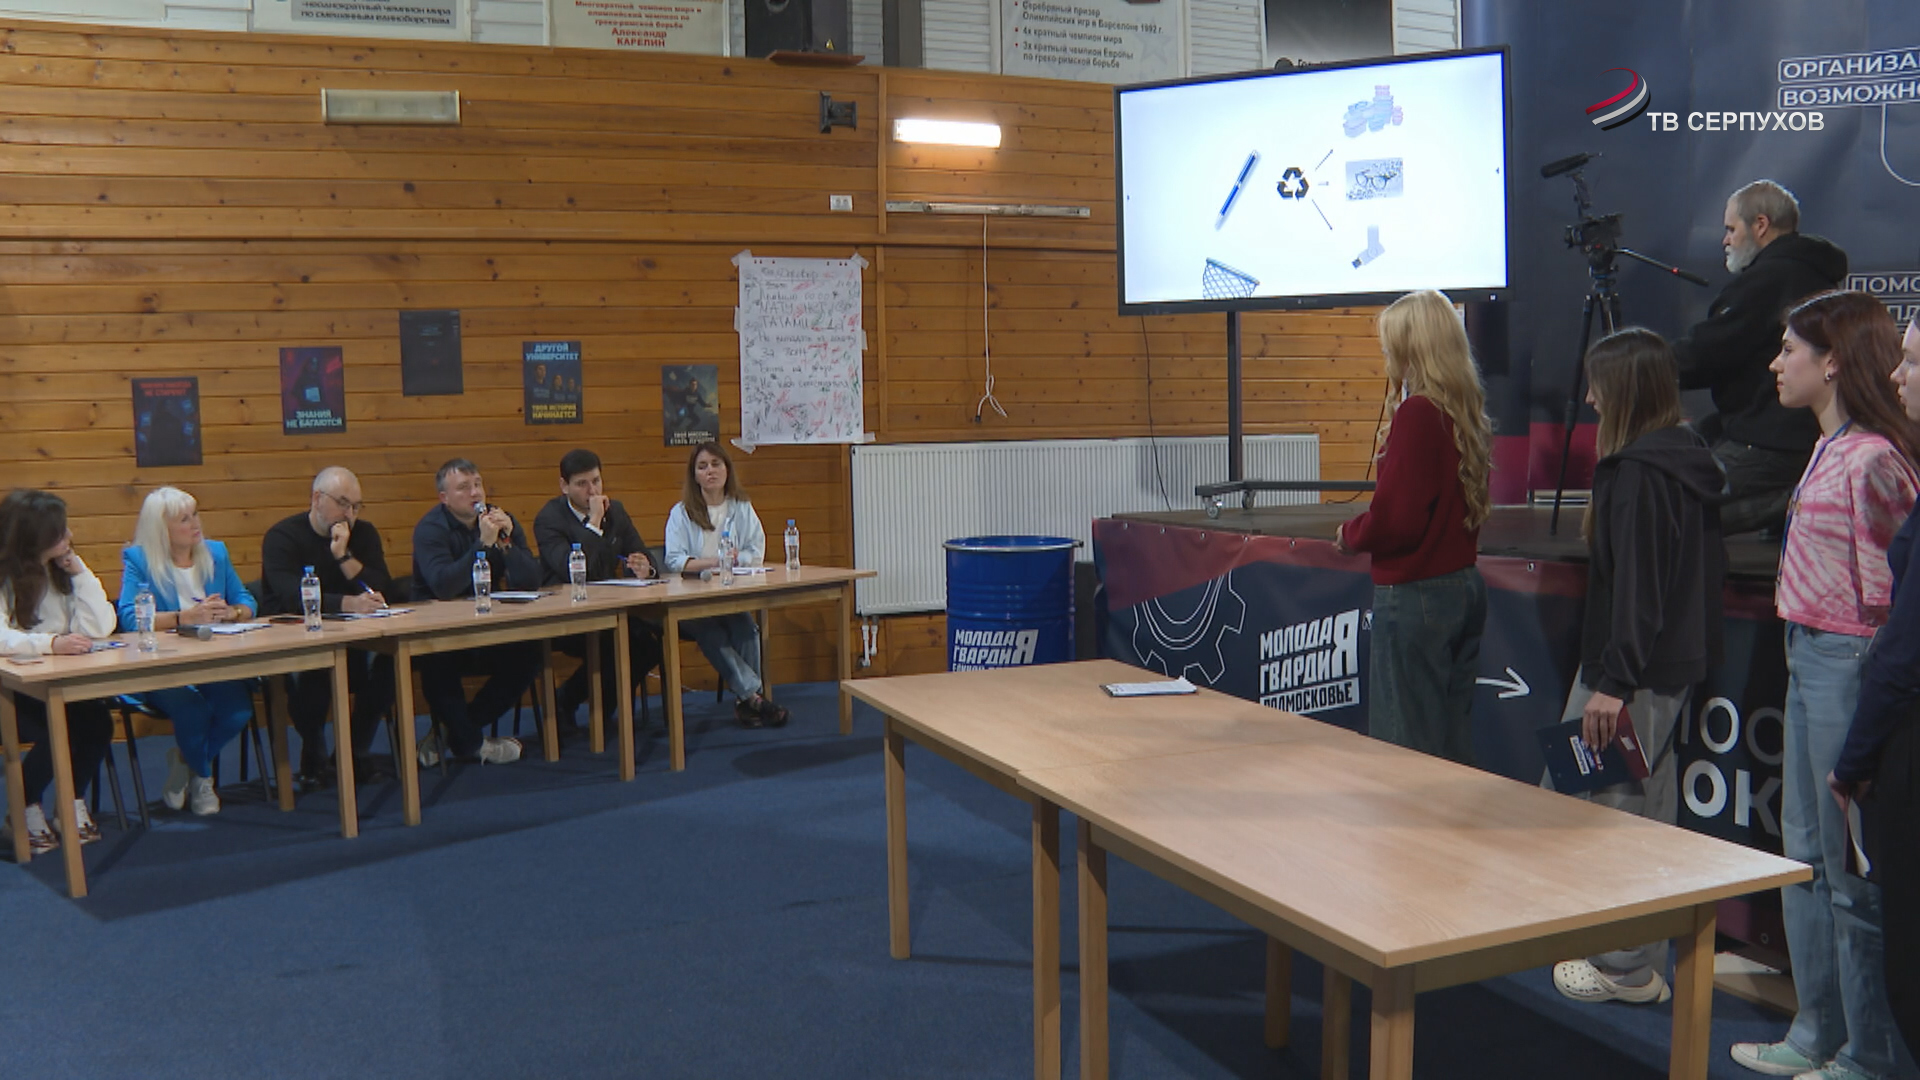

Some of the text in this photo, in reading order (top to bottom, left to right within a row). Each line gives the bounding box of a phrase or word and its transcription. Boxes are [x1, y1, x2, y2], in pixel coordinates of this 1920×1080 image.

[1022, 1, 1072, 14] Серебряный
[1022, 12, 1076, 25] Олимпийских
[1077, 17, 1090, 28] игр
[1098, 19, 1139, 32] Барселоне
[1140, 24, 1157, 34] 1992
[611, 27, 667, 39] Александр
[1033, 28, 1067, 39] кратный
[1068, 31, 1102, 42] чемпион
[1103, 35, 1123, 44] мира
[616, 37, 666, 48] КАРЕЛИН
[1033, 44, 1067, 54] кратный
[1068, 47, 1102, 57] чемпион
[1103, 47, 1134, 59] Европы
[1023, 54, 1033, 62] по
[1092, 57, 1121, 68] борьбе
[1783, 52, 1920, 79] ОРГАНИЗА
[1783, 81, 1920, 107] ВОЗМОЖН
[534, 342, 569, 352] ДРУГОЙ
[525, 352, 579, 361] УНИВЕРСИТЕТ
[295, 409, 332, 419] ЗНАНИЯ
[532, 411, 577, 419] НАЧИНАЕТСЯ
[286, 418, 298, 428] НЕ
[955, 629, 1038, 654] МОЛОДАЯ
[1261, 609, 1359, 668] МОЛОДАЯ
